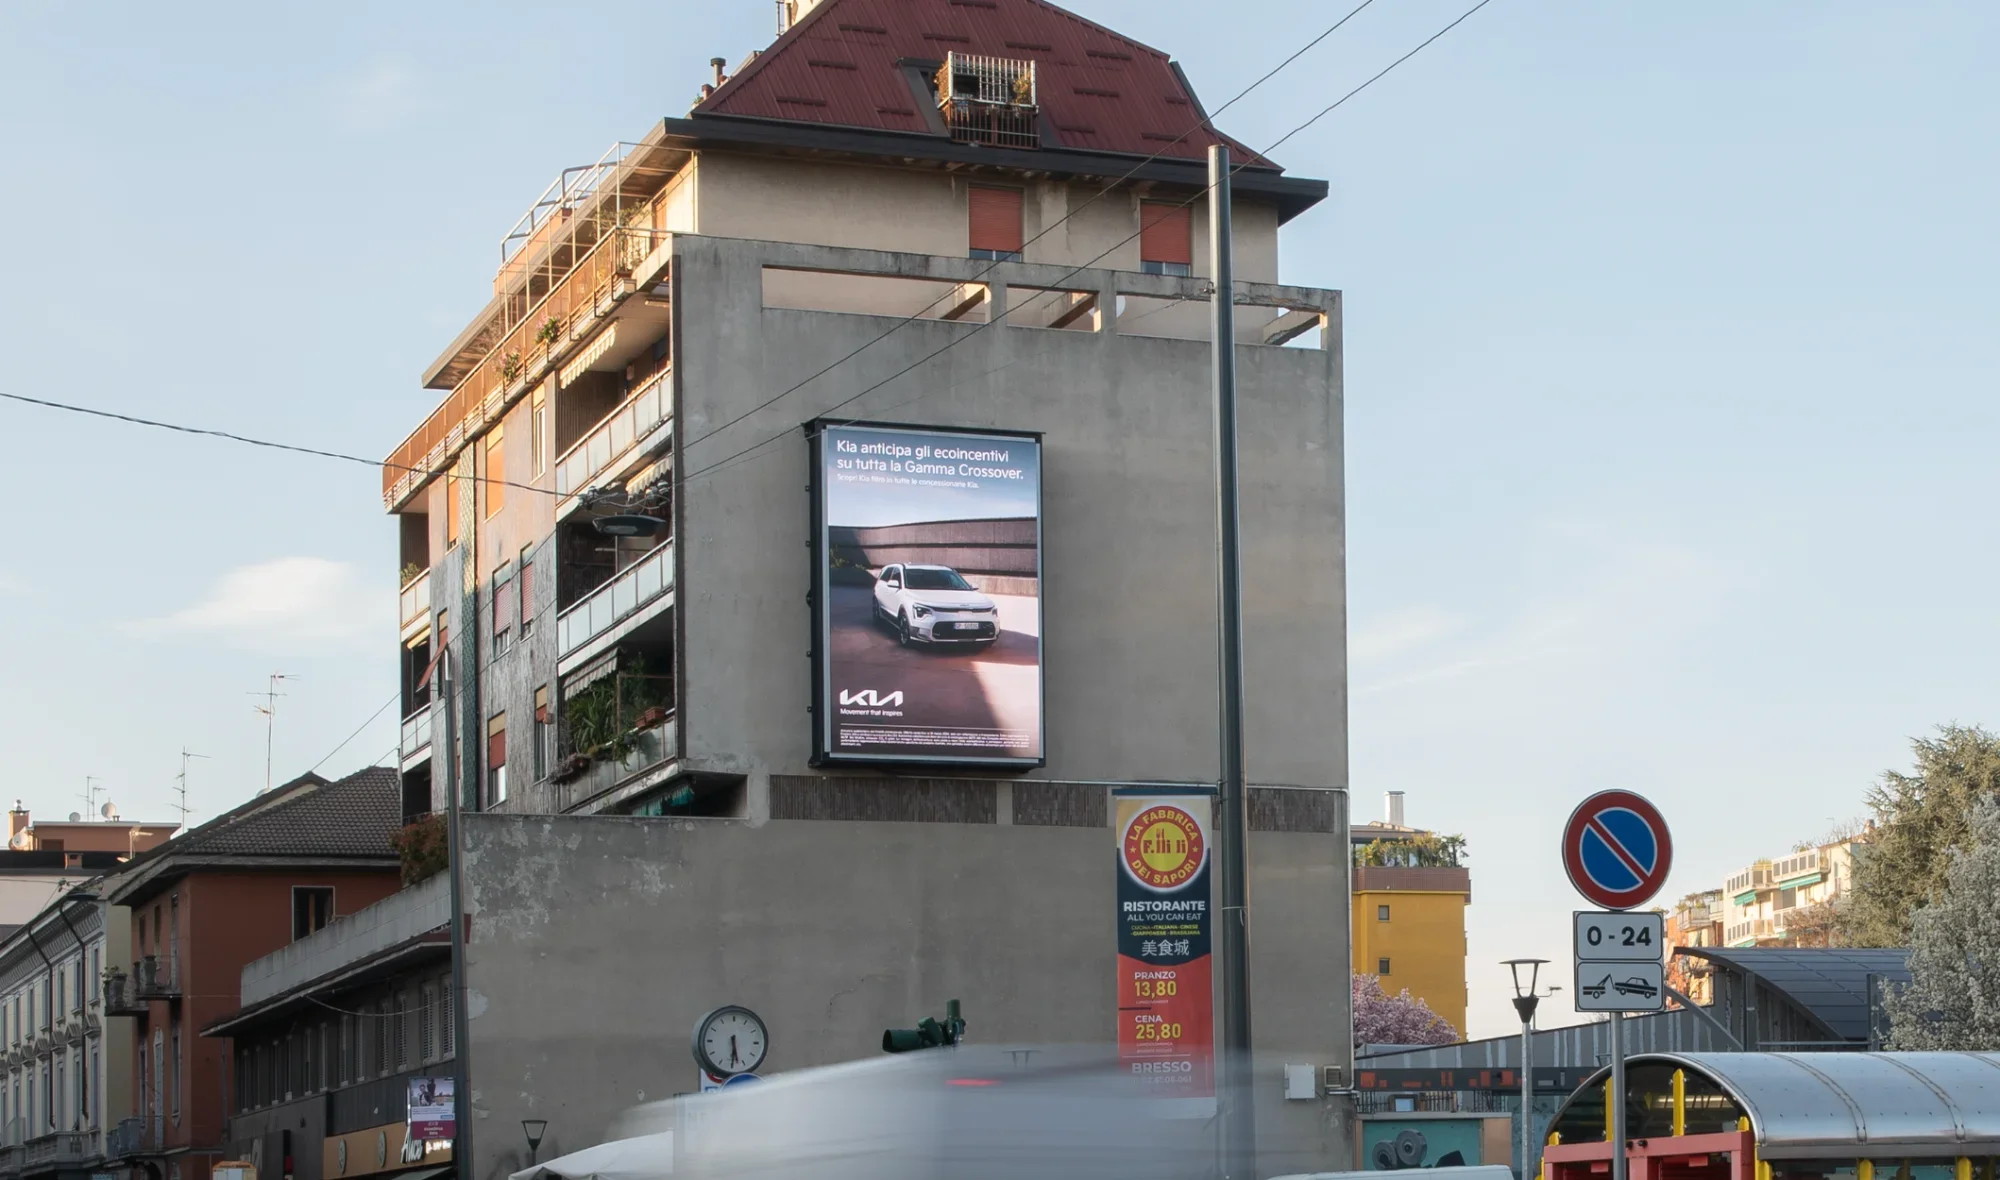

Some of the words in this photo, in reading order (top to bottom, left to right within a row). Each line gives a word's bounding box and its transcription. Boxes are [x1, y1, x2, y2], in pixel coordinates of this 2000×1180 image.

[836, 440, 857, 453] Kia
[861, 442, 911, 459] anticipa
[915, 446, 930, 461] gli
[934, 448, 1009, 463] ecoincentivi
[837, 459, 852, 469] su
[855, 457, 886, 470] tutta
[890, 460, 901, 472] la
[905, 460, 955, 476] Gamma
[959, 464, 1024, 480] Crossover.
[837, 473, 858, 482] Scopri
[886, 476, 893, 484] in
[894, 477, 910, 485] tutte
[918, 479, 966, 488] concessionarie
[967, 481, 980, 489] Kia.
[839, 689, 904, 707] KIA
[840, 708, 870, 716] Movement
[870, 709, 882, 717] that
[882, 709, 903, 718] inspires
[1129, 825, 1143, 841] LA
[1142, 809, 1199, 841] FABBRICA
[1131, 859, 1151, 880] DEI
[1152, 858, 1197, 885] SAPORI
[1123, 900, 1206, 912] RISTORANTE
[1127, 914, 1144, 922] ALL
[1145, 913, 1164, 922] YOU
[1165, 913, 1184, 921] CAN
[1186, 912, 1202, 921] EAT
[1587, 926, 1602, 946] 0
[1621, 926, 1652, 946] 24
[1141, 939, 1190, 957] 美食城
[1134, 971, 1176, 980] PRANZO
[1134, 980, 1177, 999] 13,80
[1135, 1014, 1163, 1023] CENA
[1135, 1023, 1182, 1041] 25,80
[1131, 1061, 1192, 1074] BRESSO
